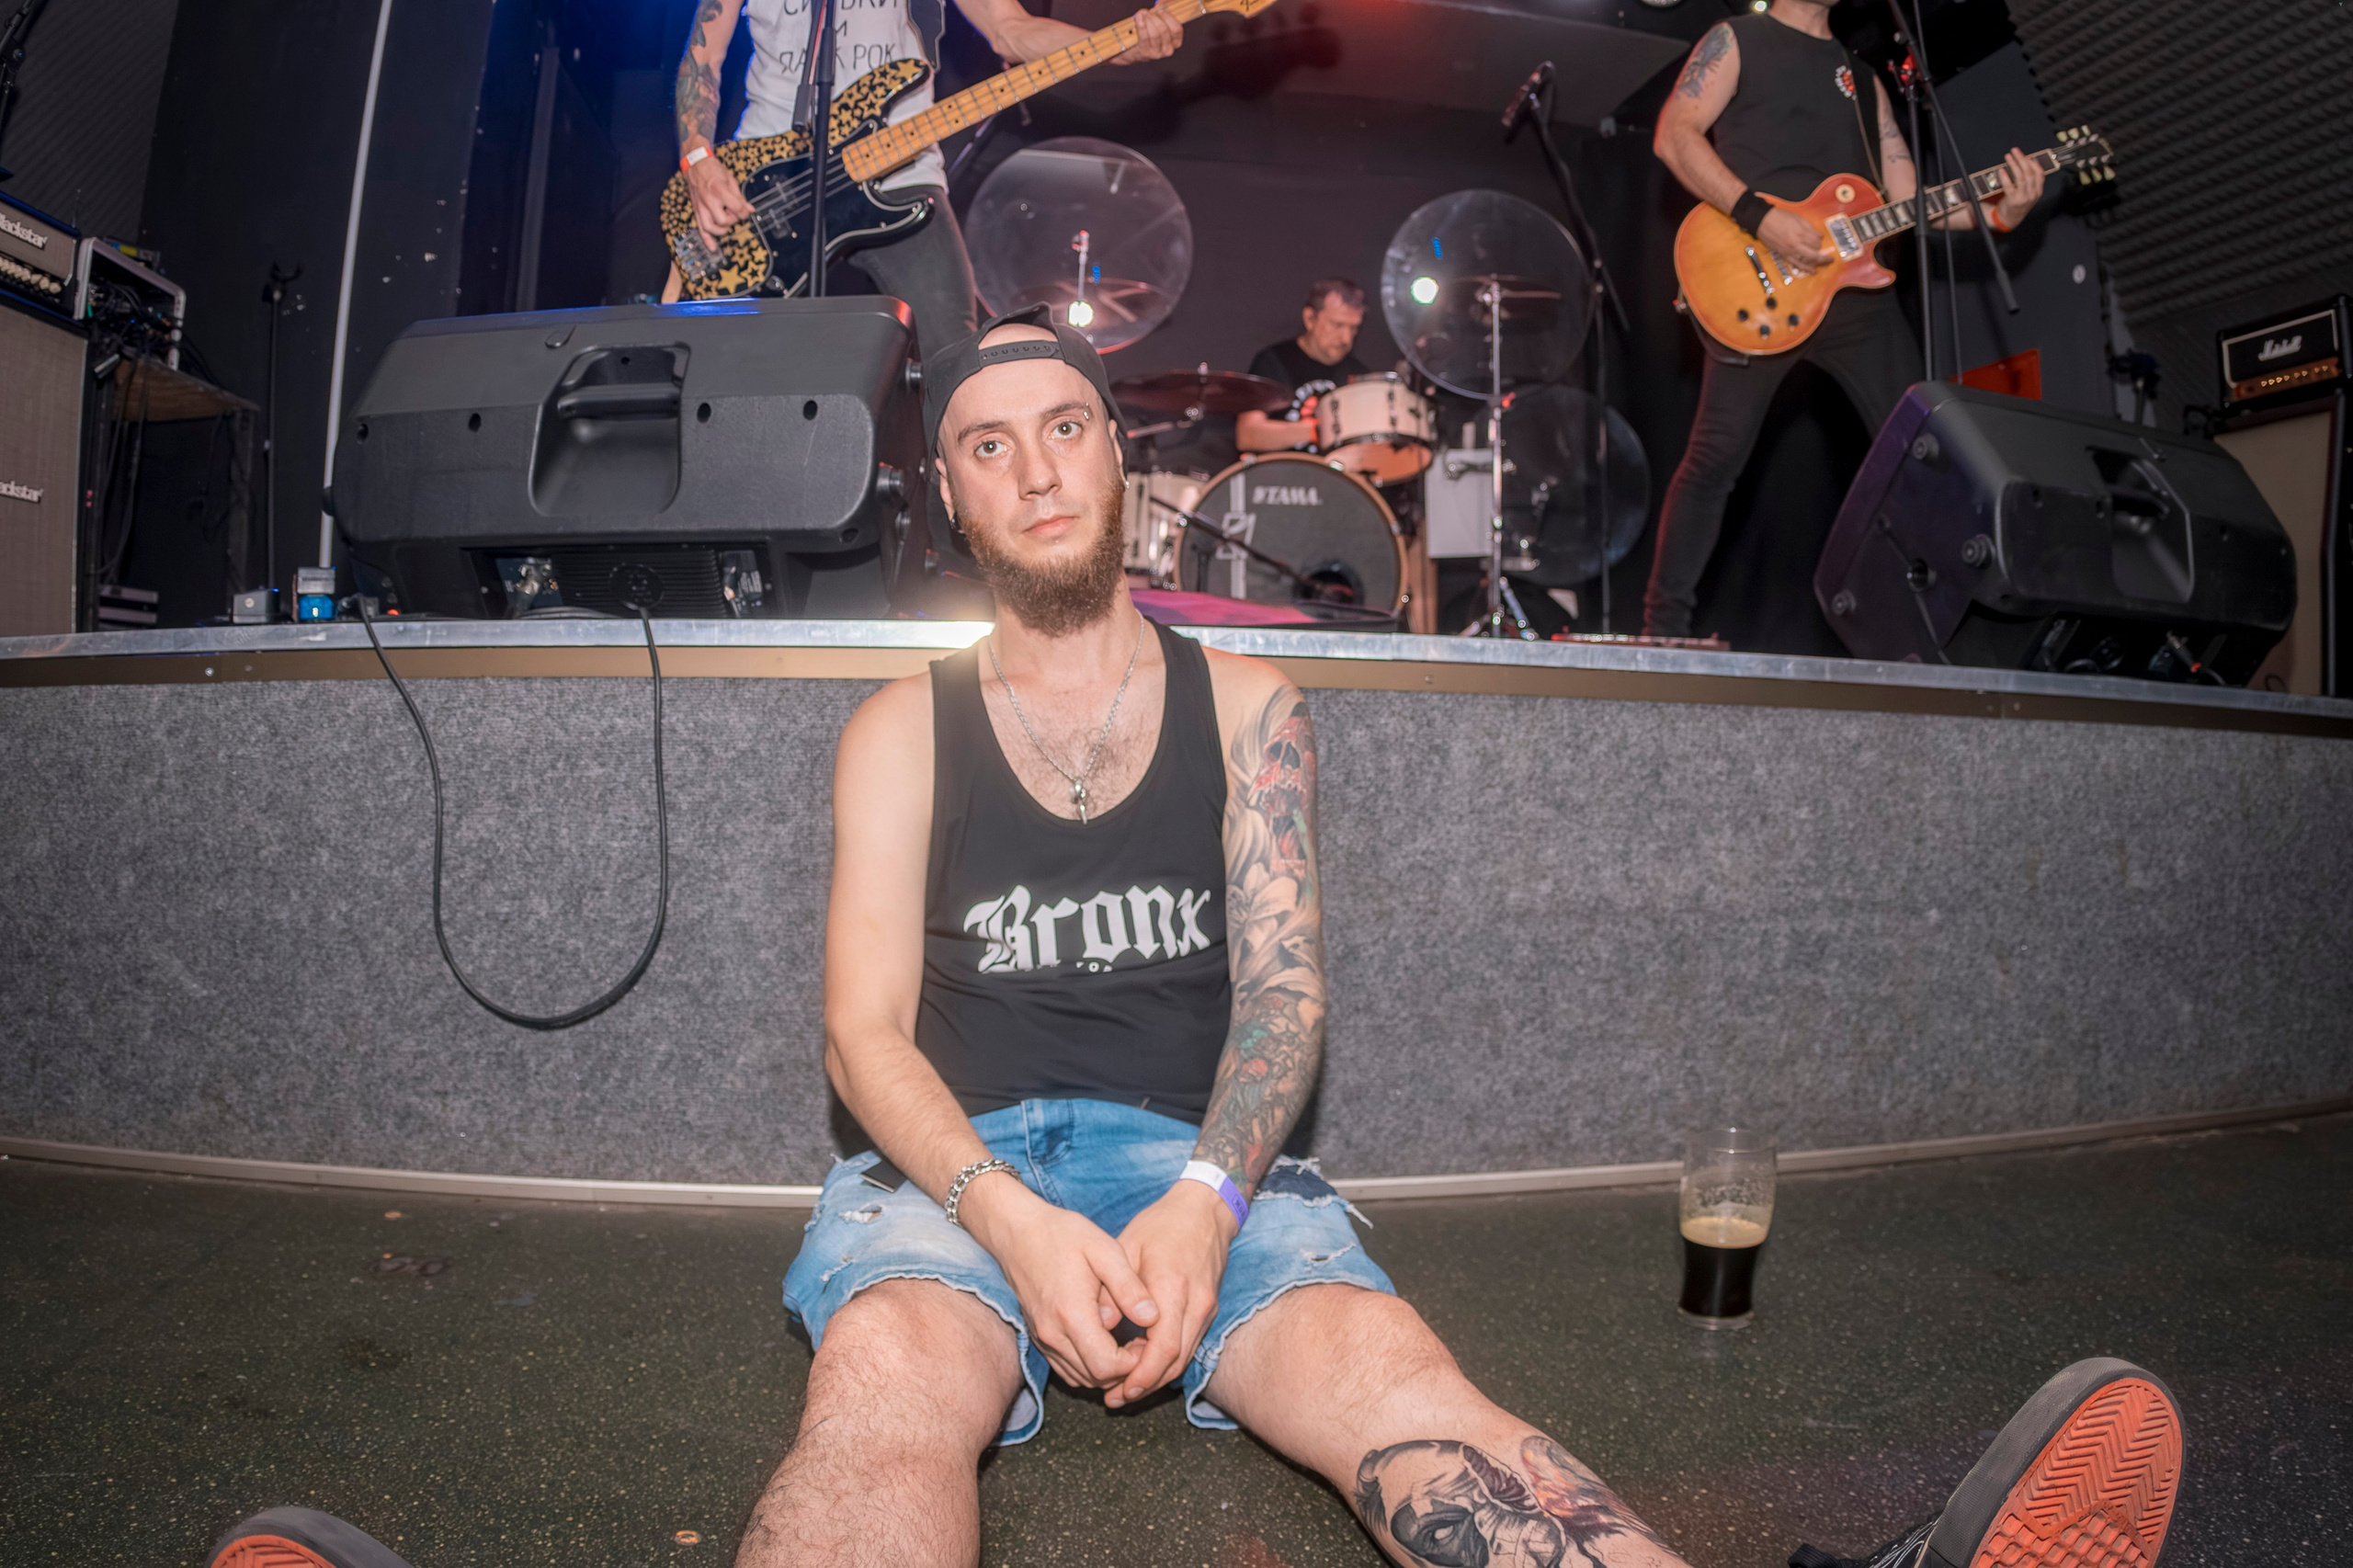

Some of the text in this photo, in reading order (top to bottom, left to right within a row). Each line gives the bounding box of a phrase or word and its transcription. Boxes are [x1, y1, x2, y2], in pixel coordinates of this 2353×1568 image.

[853, 43, 895, 71] РОК
[0, 212, 48, 248] lackstar
[963, 884, 1211, 973] Bronx
